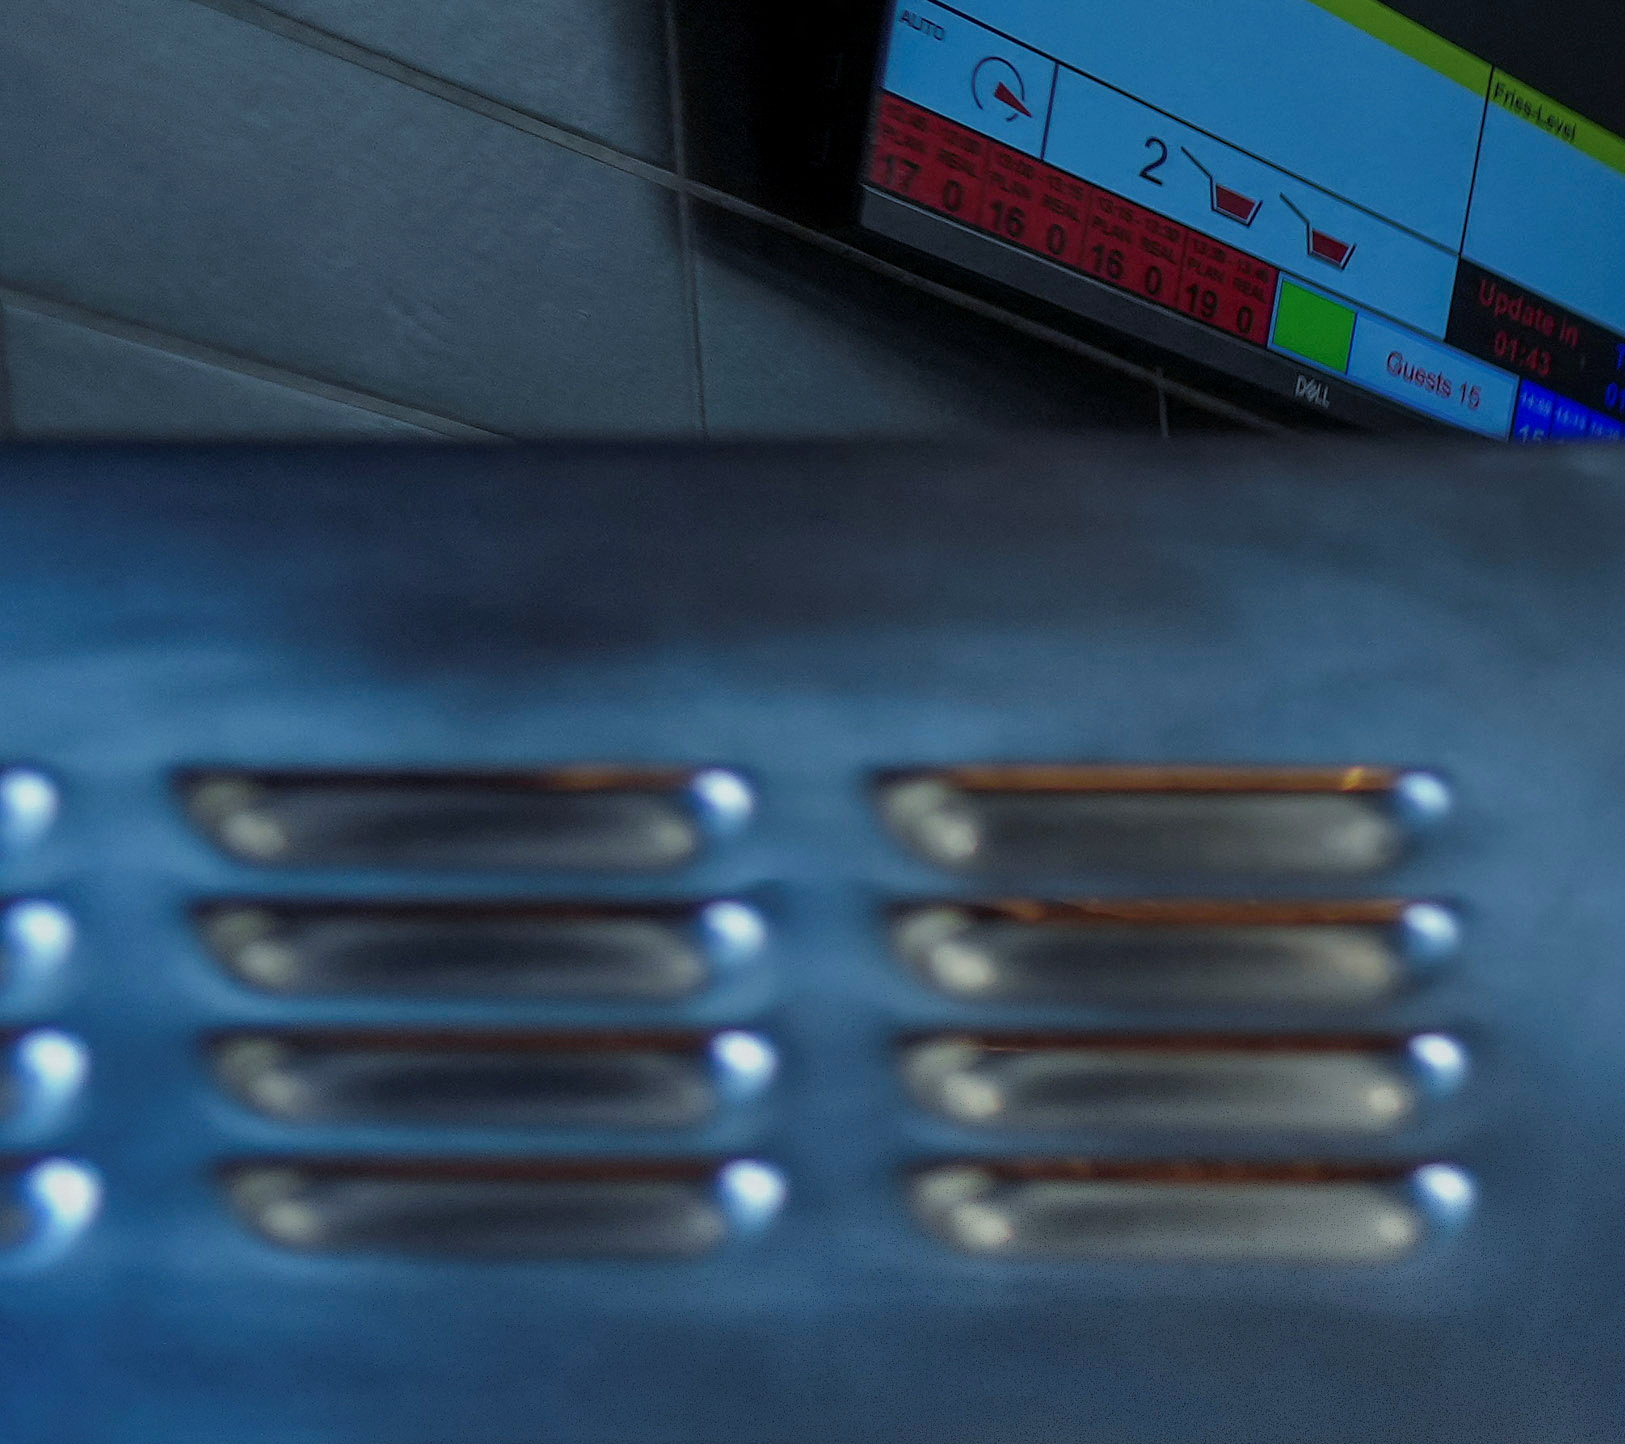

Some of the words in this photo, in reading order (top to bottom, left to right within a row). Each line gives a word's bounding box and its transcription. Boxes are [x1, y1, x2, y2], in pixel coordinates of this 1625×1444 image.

[899, 9, 946, 41] AUTO
[1139, 137, 1168, 186] 2
[884, 155, 921, 192] 17
[942, 179, 963, 212] 0
[991, 200, 1026, 238] 16
[1046, 224, 1066, 255] 0
[1093, 243, 1124, 280] 16
[1145, 265, 1162, 295] 0
[1187, 283, 1218, 318] 19
[1237, 306, 1254, 333] 0
[1477, 279, 1556, 337] Update
[1559, 316, 1580, 349] in
[1494, 330, 1552, 377] 01:43
[1294, 374, 1331, 410] DELL
[1386, 350, 1450, 399] Guests
[1458, 379, 1482, 411] 15
